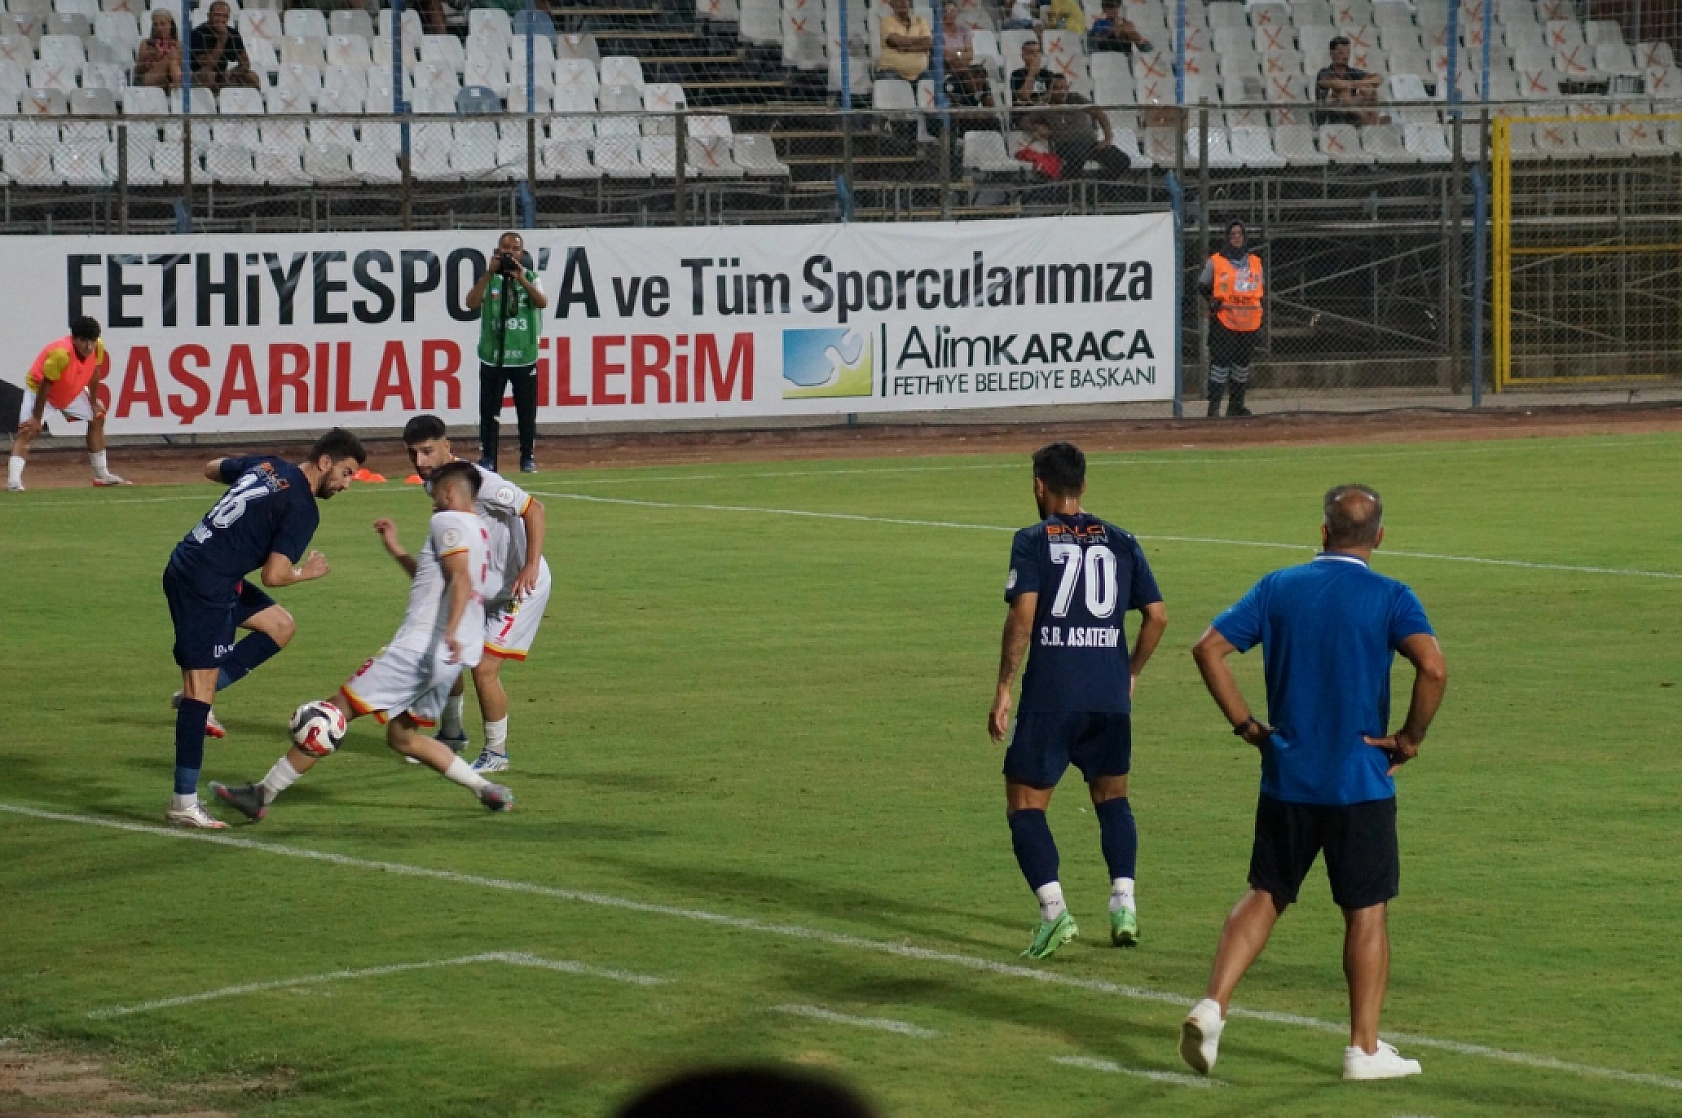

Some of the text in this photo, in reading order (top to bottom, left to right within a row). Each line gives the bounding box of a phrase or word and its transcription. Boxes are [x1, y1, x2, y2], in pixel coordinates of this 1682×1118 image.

[67, 247, 1153, 328] FETHiYESPO'A ve Tüm Sporcularımıza
[502, 334, 753, 406] iLERiM
[1070, 367, 1156, 390] BAŞKANI
[1049, 544, 1118, 618] 70
[498, 611, 515, 638] 7
